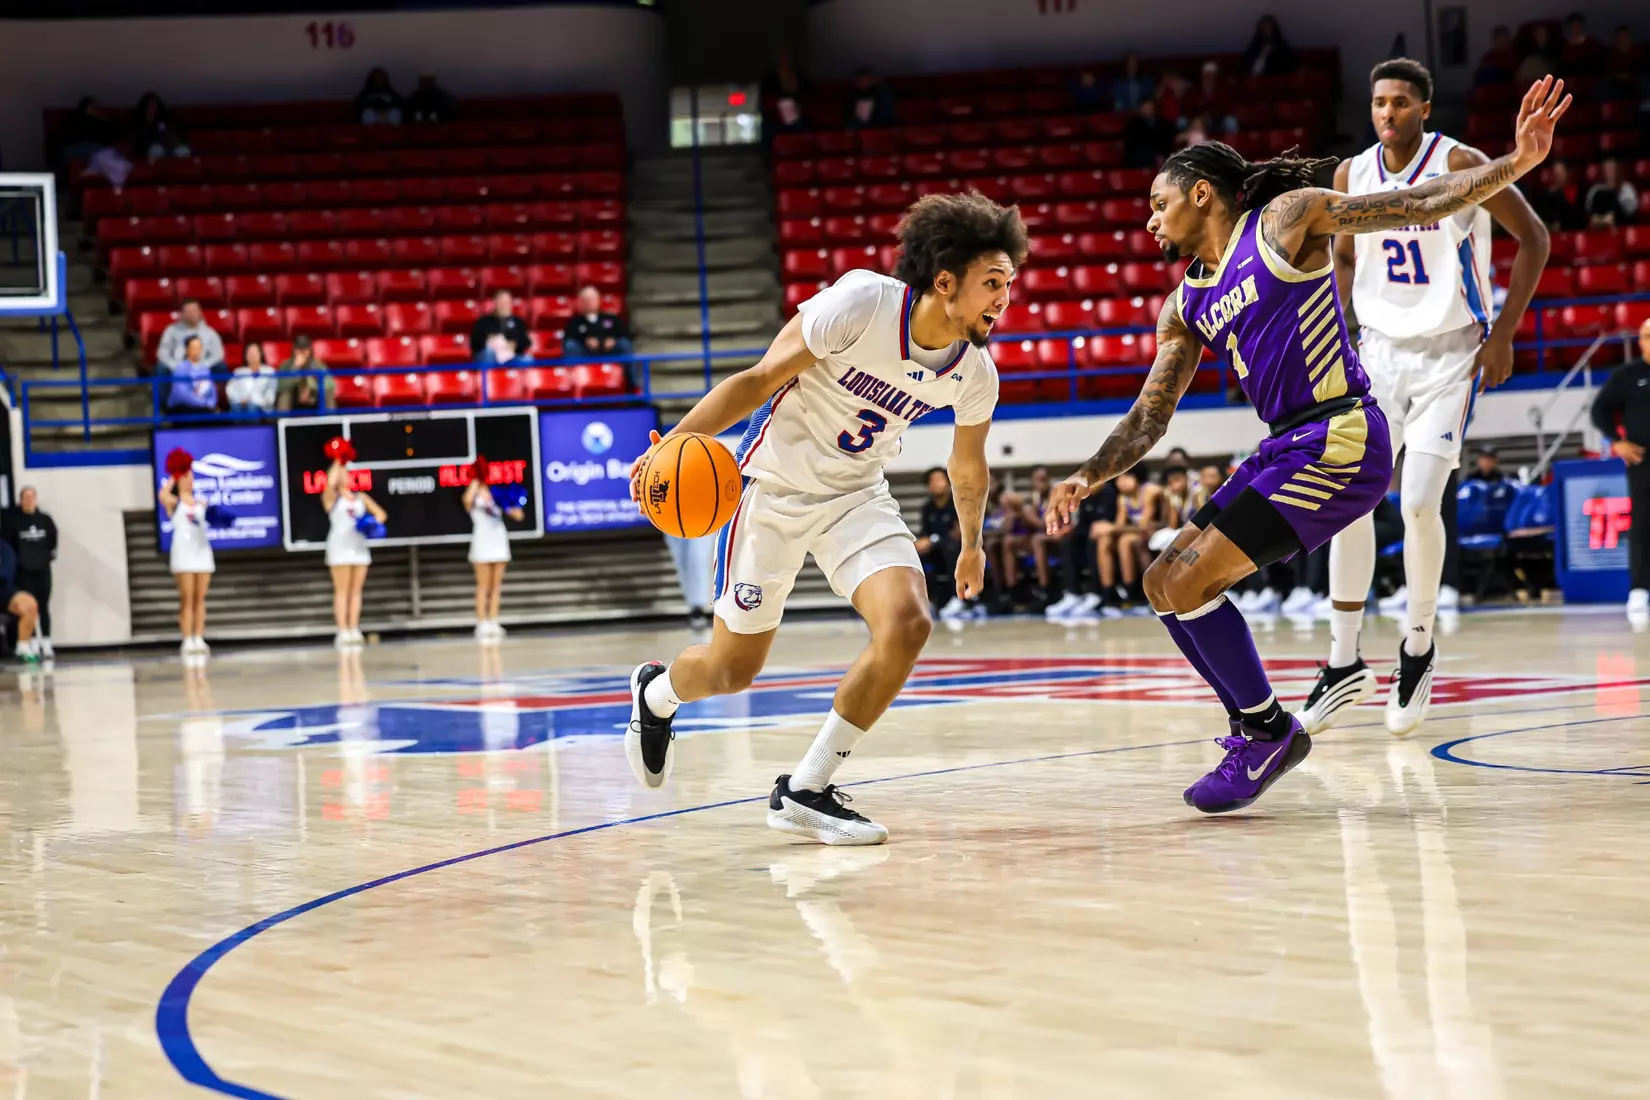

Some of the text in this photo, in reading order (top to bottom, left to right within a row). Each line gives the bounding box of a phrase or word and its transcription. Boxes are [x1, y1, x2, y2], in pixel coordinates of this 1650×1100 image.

[304, 21, 357, 50] 116
[1382, 238, 1430, 286] 21
[837, 366, 913, 417] LOUISIANA
[837, 408, 888, 453] 3
